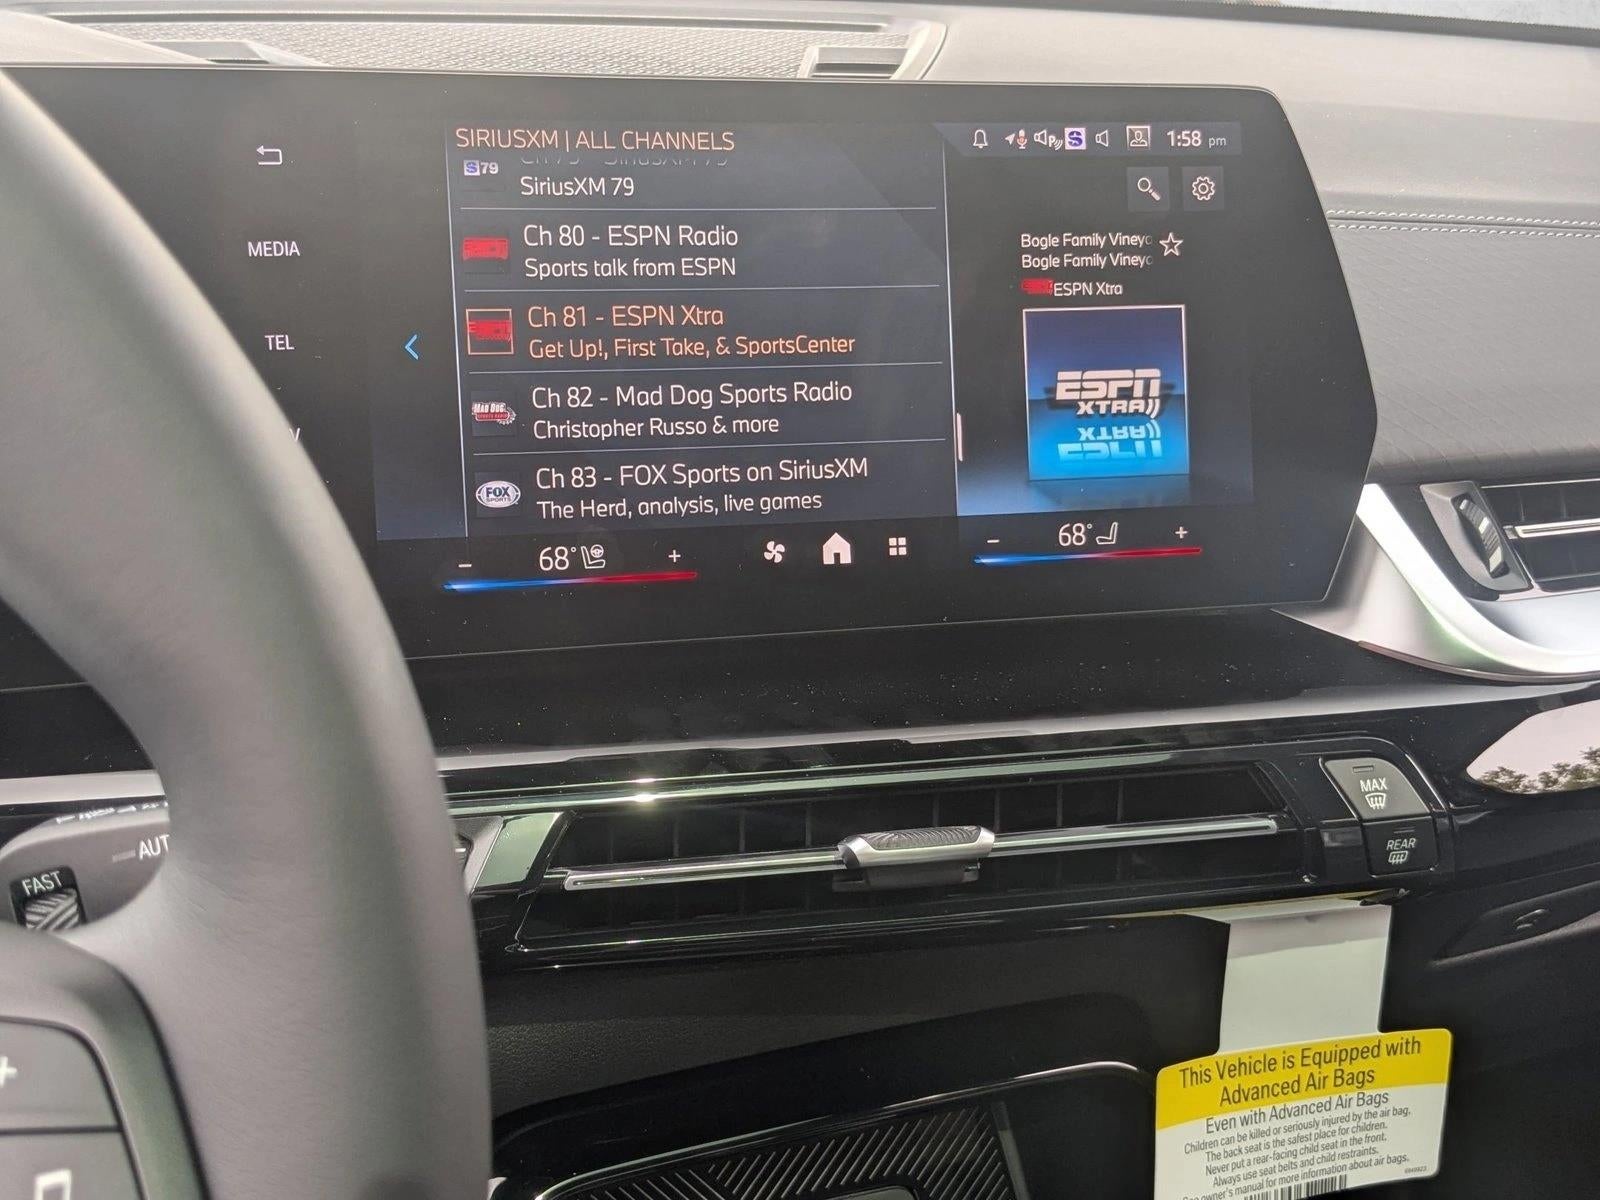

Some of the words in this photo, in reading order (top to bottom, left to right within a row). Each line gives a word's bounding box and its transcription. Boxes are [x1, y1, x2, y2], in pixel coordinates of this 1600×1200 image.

[455, 128, 558, 149] SIRIUSXM
[575, 130, 616, 150] ALL
[621, 131, 735, 150] CHANNELS
[1166, 130, 1202, 147] 1:58
[1208, 137, 1227, 149] pm
[520, 176, 606, 196] SiriusXM
[610, 177, 635, 196] 79
[523, 224, 552, 246] Ch
[558, 224, 585, 246] 80
[608, 224, 671, 246] ESPN
[678, 225, 739, 246] Radio
[1020, 233, 1059, 250] Bogle
[1062, 232, 1106, 249] Family
[247, 241, 301, 257] MEDIA
[1021, 253, 1060, 270] Bogle
[1063, 253, 1107, 269] Family
[525, 258, 588, 281] Sports
[593, 258, 629, 277] talk
[633, 257, 677, 277] from
[681, 257, 737, 277] ESPN
[1053, 281, 1093, 296] ESPN
[1095, 281, 1124, 296] Xtra
[528, 306, 556, 327] Ch
[563, 305, 587, 327] 81
[612, 305, 675, 327] ESPN
[681, 304, 725, 326] Xtra
[264, 334, 295, 350] TEL
[529, 339, 564, 359] Get
[569, 338, 609, 361] Up!,
[614, 337, 657, 357] First
[660, 336, 710, 359] Take,
[716, 336, 731, 356] &
[735, 335, 856, 358] SportsCenter
[532, 387, 561, 409] Ch
[567, 386, 594, 408] 82
[616, 384, 663, 407] Mad
[669, 384, 713, 410] Dog
[719, 383, 788, 408] Sports
[793, 381, 853, 403] Radio
[1055, 368, 1161, 400] ESPN
[1076, 400, 1146, 416] XTRA
[533, 418, 644, 441] Christopher
[649, 417, 707, 436] Russo
[712, 415, 728, 434] &
[732, 418, 779, 434] more
[536, 467, 565, 489] Ch
[571, 466, 597, 488] 83
[620, 464, 668, 486] FOX
[672, 463, 740, 488] Sports
[747, 465, 773, 482] on
[779, 457, 868, 481] SiriusXM
[485, 486, 511, 498] FOX
[536, 500, 574, 519] The
[580, 498, 632, 519] Herd,
[638, 495, 719, 517] analysis,
[724, 494, 755, 512] live
[760, 494, 822, 515] games
[1359, 777, 1388, 792] MAX
[138, 834, 171, 860] AUT
[1386, 838, 1416, 851] REAR
[21, 870, 64, 896] FAST
[1179, 1063, 1212, 1088] This
[1216, 1053, 1277, 1080] Vehicle
[1282, 1050, 1295, 1070] is
[1301, 1038, 1381, 1069] Equipped
[1386, 1036, 1421, 1057] with
[1219, 1074, 1301, 1107] Advanced
[1305, 1071, 1328, 1092] Air
[1333, 1068, 1375, 1089] Bags
[1205, 1117, 1237, 1135] Even
[1240, 1109, 1266, 1128] with
[1269, 1096, 1332, 1121] Advanced
[1335, 1094, 1353, 1110] Air
[1356, 1091, 1389, 1109] Bags
[1184, 1139, 1219, 1155] Children
[1220, 1135, 1235, 1146] can
[1237, 1131, 1248, 1142] be
[1249, 1126, 1271, 1140] killed
[1273, 1126, 1282, 1136] or
[1283, 1118, 1320, 1132] seriously
[1321, 1113, 1351, 1127] injured
[1352, 1111, 1363, 1122] by
[1364, 1109, 1378, 1120] the
[1379, 1108, 1391, 1119] air
[1205, 1151, 1222, 1162] The
[1223, 1146, 1243, 1159] back
[1244, 1142, 1262, 1154] seat
[1263, 1139, 1271, 1150] is
[1272, 1137, 1286, 1149] the
[1287, 1130, 1313, 1145] safest
[1314, 1128, 1337, 1142] place
[1338, 1125, 1349, 1136] for
[1351, 1121, 1388, 1135] children.
[1205, 1162, 1229, 1176] Never
[1231, 1158, 1245, 1171] put
[1246, 1157, 1252, 1167] a
[1253, 1148, 1298, 1165] rear-facing
[1299, 1142, 1319, 1155] child
[1320, 1140, 1338, 1151] seat
[1340, 1137, 1348, 1148] in
[1349, 1135, 1363, 1146] the
[1213, 1174, 1241, 1188] Always
[1242, 1169, 1258, 1181] use
[1259, 1164, 1276, 1177] seat
[1278, 1160, 1298, 1174] belts
[1299, 1155, 1315, 1168] and
[1316, 1151, 1336, 1164] child
[1234, 1180, 1264, 1195] manual
[1265, 1177, 1276, 1189] for
[1278, 1173, 1300, 1186] more
[1301, 1162, 1348, 1180] information
[1348, 1158, 1373, 1172] about
[1373, 1156, 1385, 1167] air
